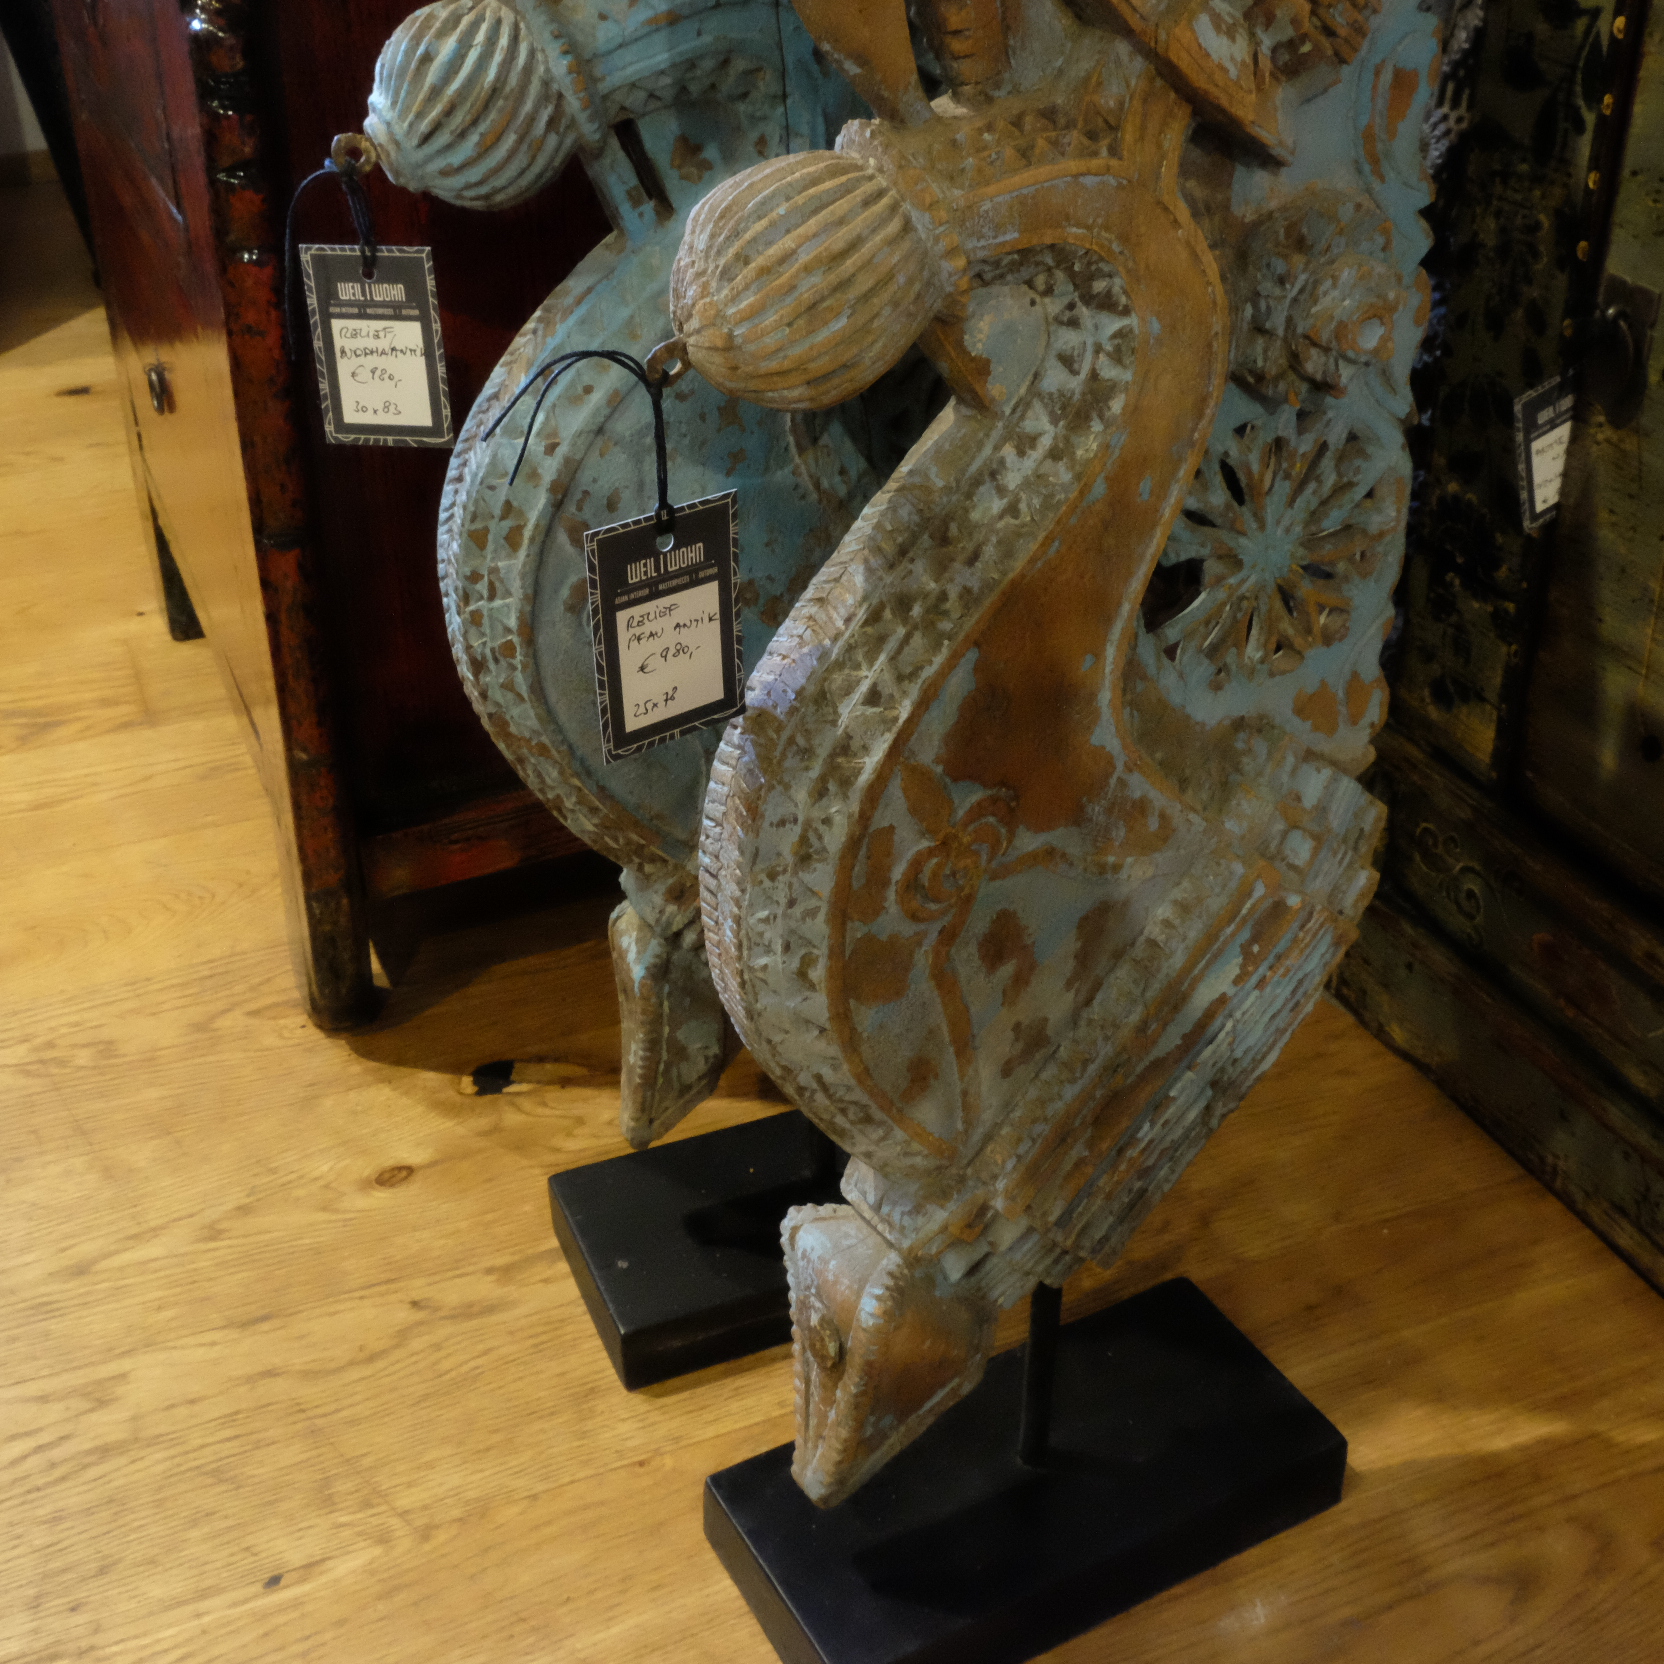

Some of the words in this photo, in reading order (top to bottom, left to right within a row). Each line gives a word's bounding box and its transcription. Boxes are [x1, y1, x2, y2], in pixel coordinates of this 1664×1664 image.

[338, 282, 364, 301] WEIL
[371, 283, 406, 302] WOHN
[627, 557, 657, 584] WEIL
[667, 542, 704, 573] WOHN
